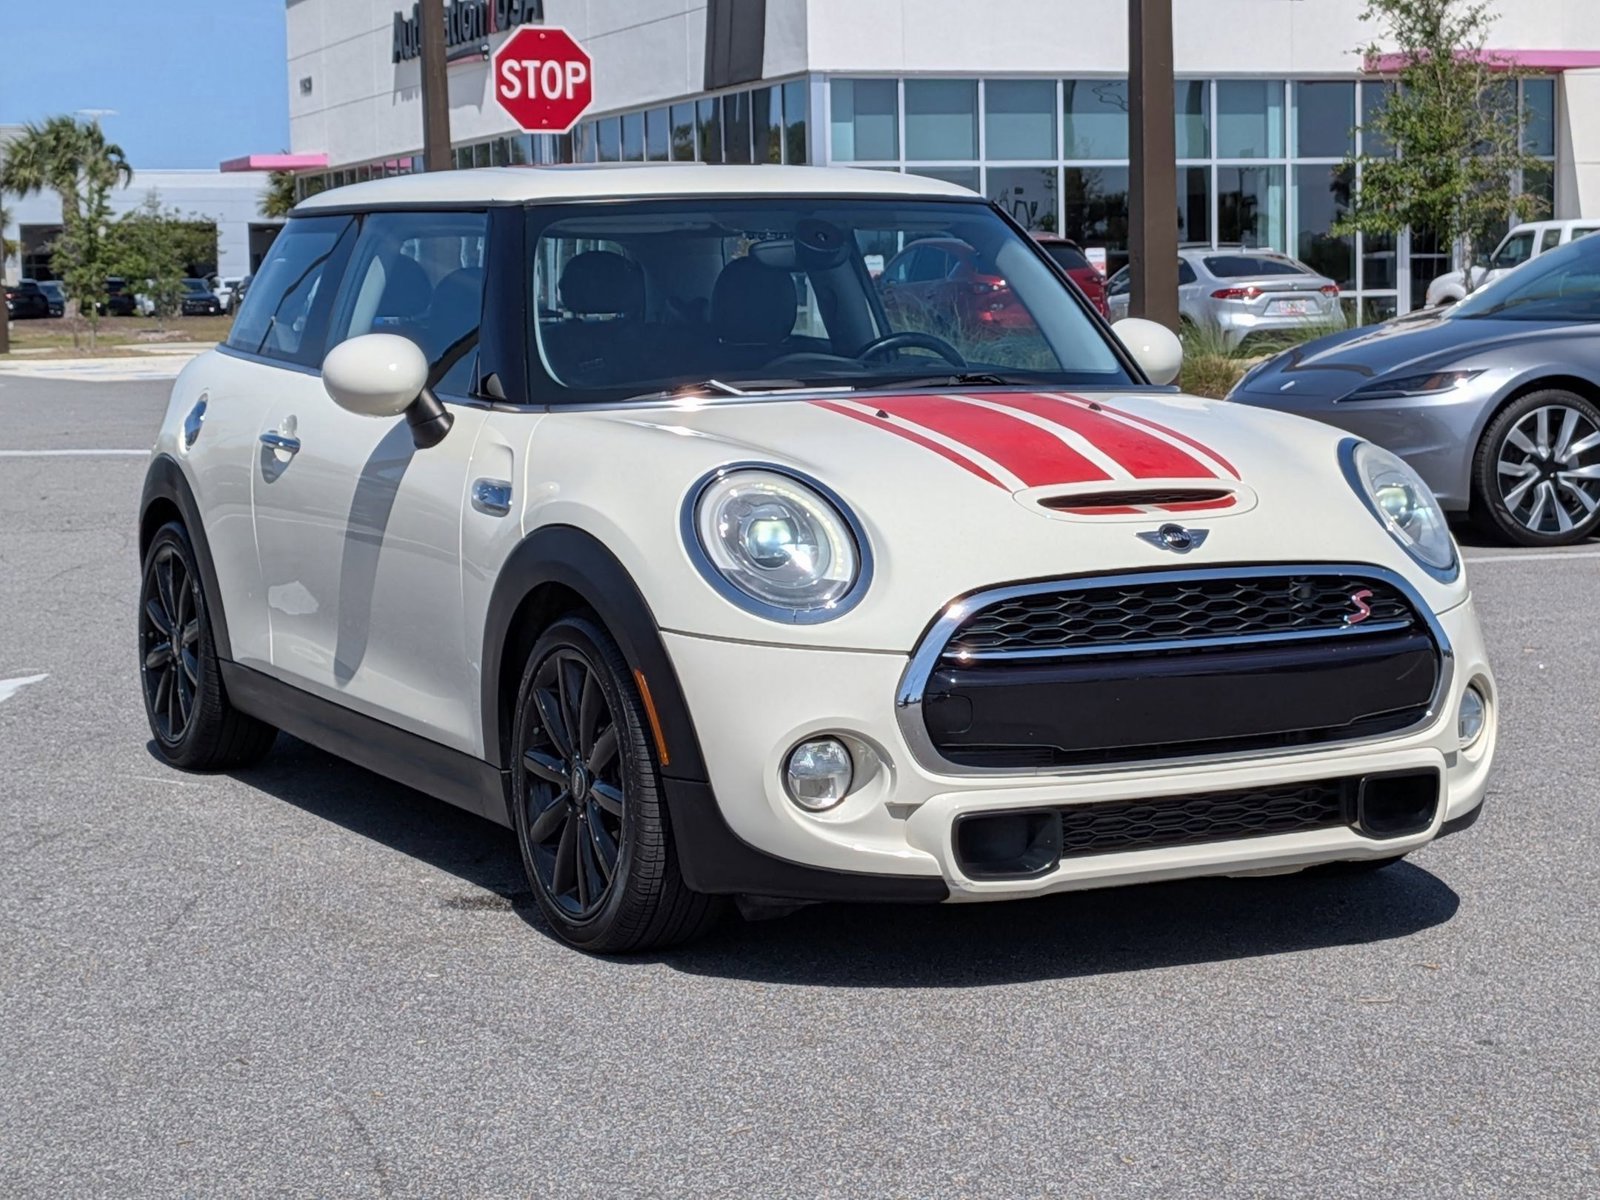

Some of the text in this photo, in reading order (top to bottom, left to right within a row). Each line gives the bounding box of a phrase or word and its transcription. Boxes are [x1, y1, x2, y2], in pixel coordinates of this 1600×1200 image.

[392, 0, 486, 63] Autation
[500, 59, 587, 100] STOP
[1344, 590, 1373, 624] S
